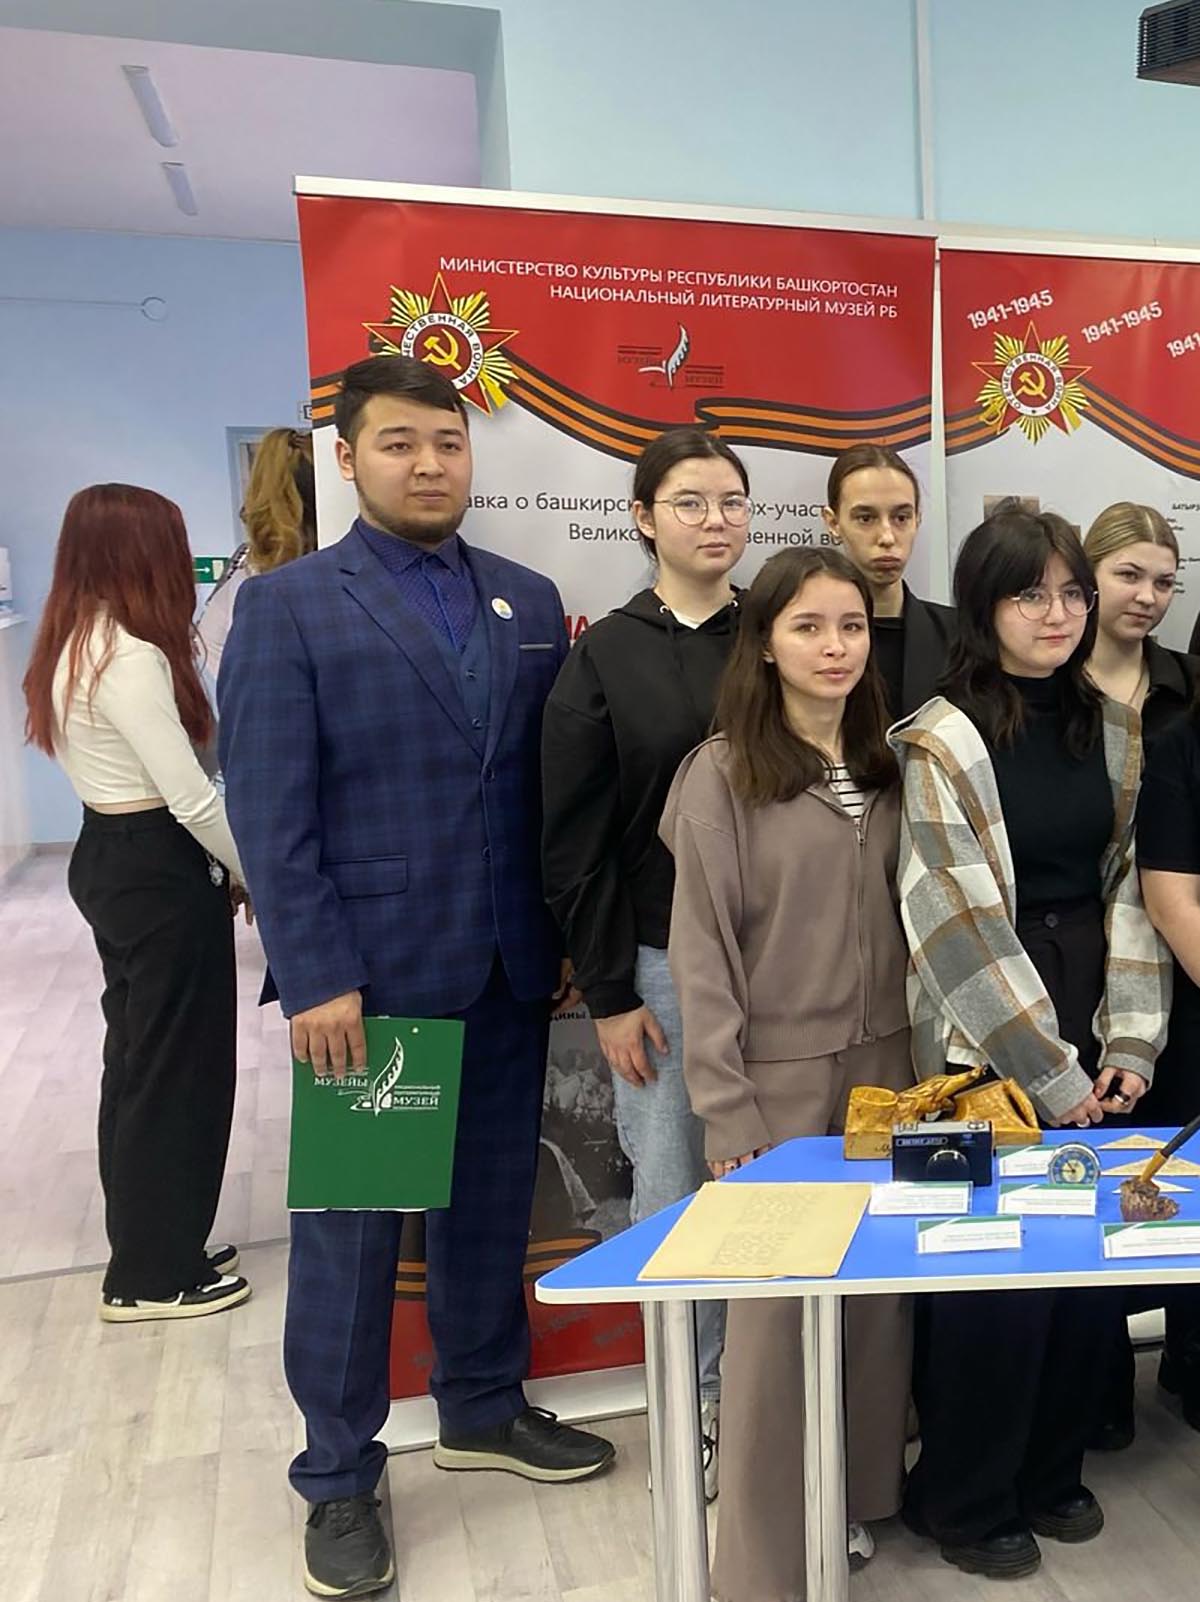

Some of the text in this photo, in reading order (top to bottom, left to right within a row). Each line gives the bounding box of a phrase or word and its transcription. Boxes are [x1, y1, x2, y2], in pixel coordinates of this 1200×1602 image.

[440, 256, 898, 298] МИНИСТЕРСТВО КУЛЬТУРЫ РЕСПУБЛИКИ БАШКОРТОСТАН
[550, 284, 898, 319] НАЦИОНАЛЬНЫЙ ЛИТЕРАТУРНЫЙ МУЗЕЙ РБ
[966, 289, 1054, 330] 1941-1945
[1081, 301, 1163, 344] 1941-1945
[515, 496, 529, 510] о
[569, 523, 642, 542] Велико
[393, 1096, 439, 1106] МУЗЕЙ
